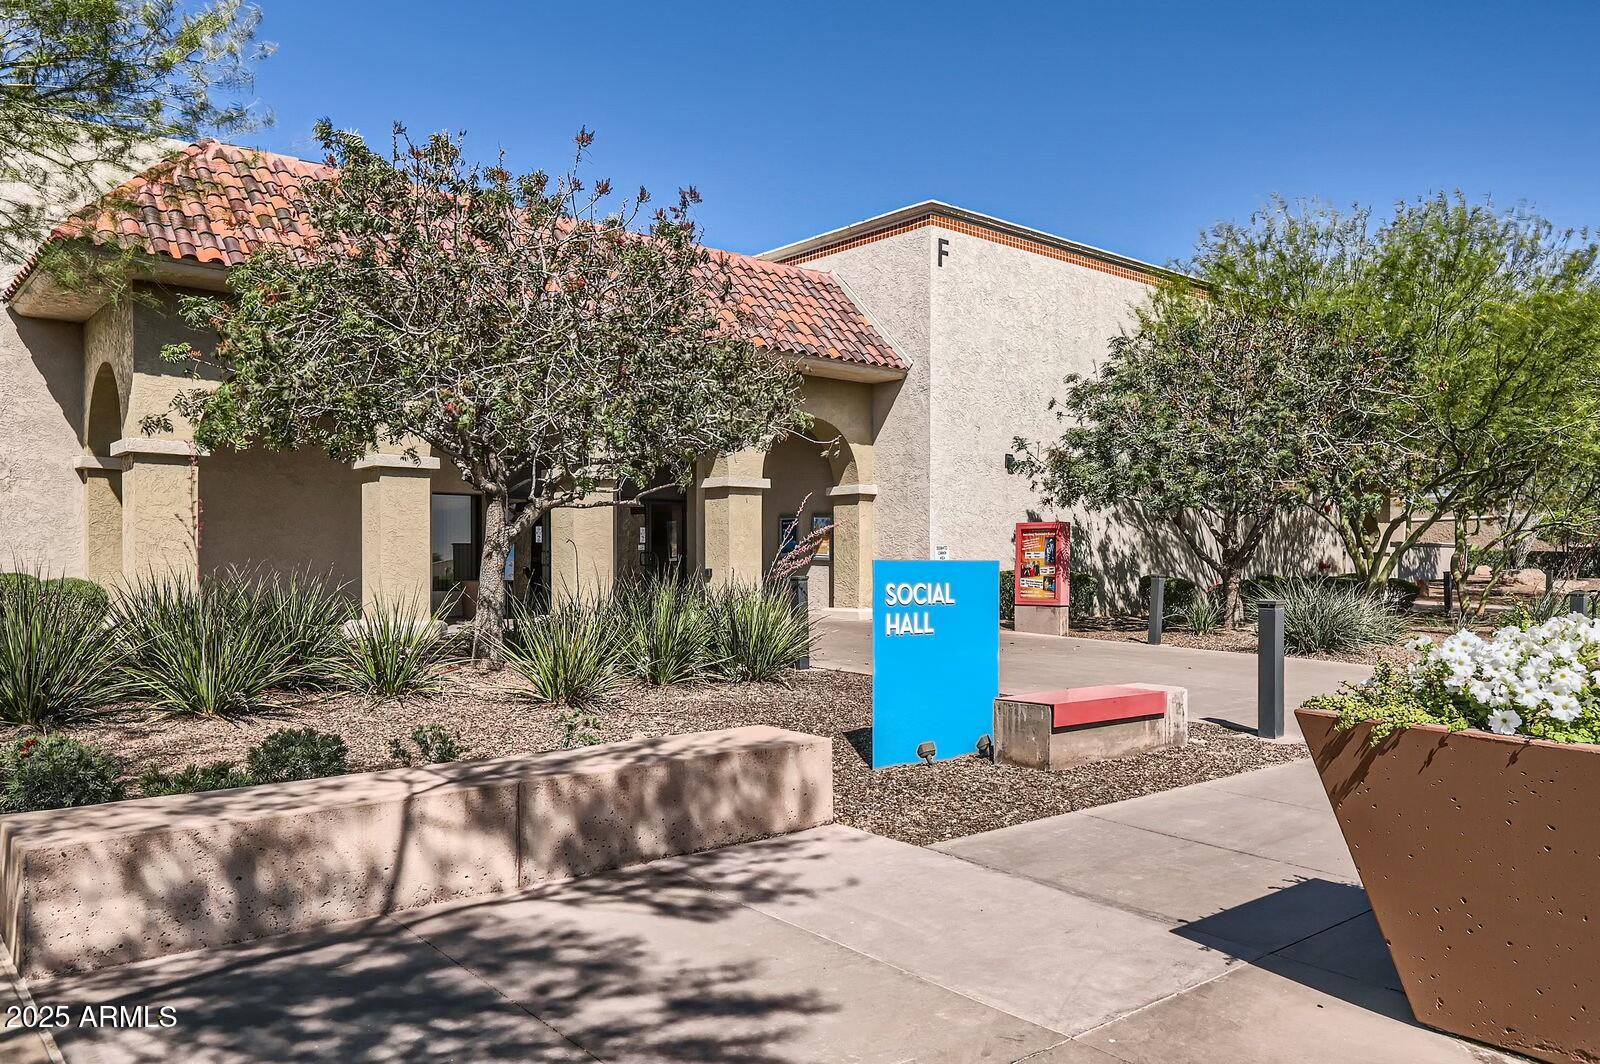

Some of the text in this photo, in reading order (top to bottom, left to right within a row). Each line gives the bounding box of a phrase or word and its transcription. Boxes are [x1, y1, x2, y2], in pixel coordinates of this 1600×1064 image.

[938, 238, 949, 267] F
[886, 583, 955, 606] SOCIAL
[886, 612, 934, 636] HALL
